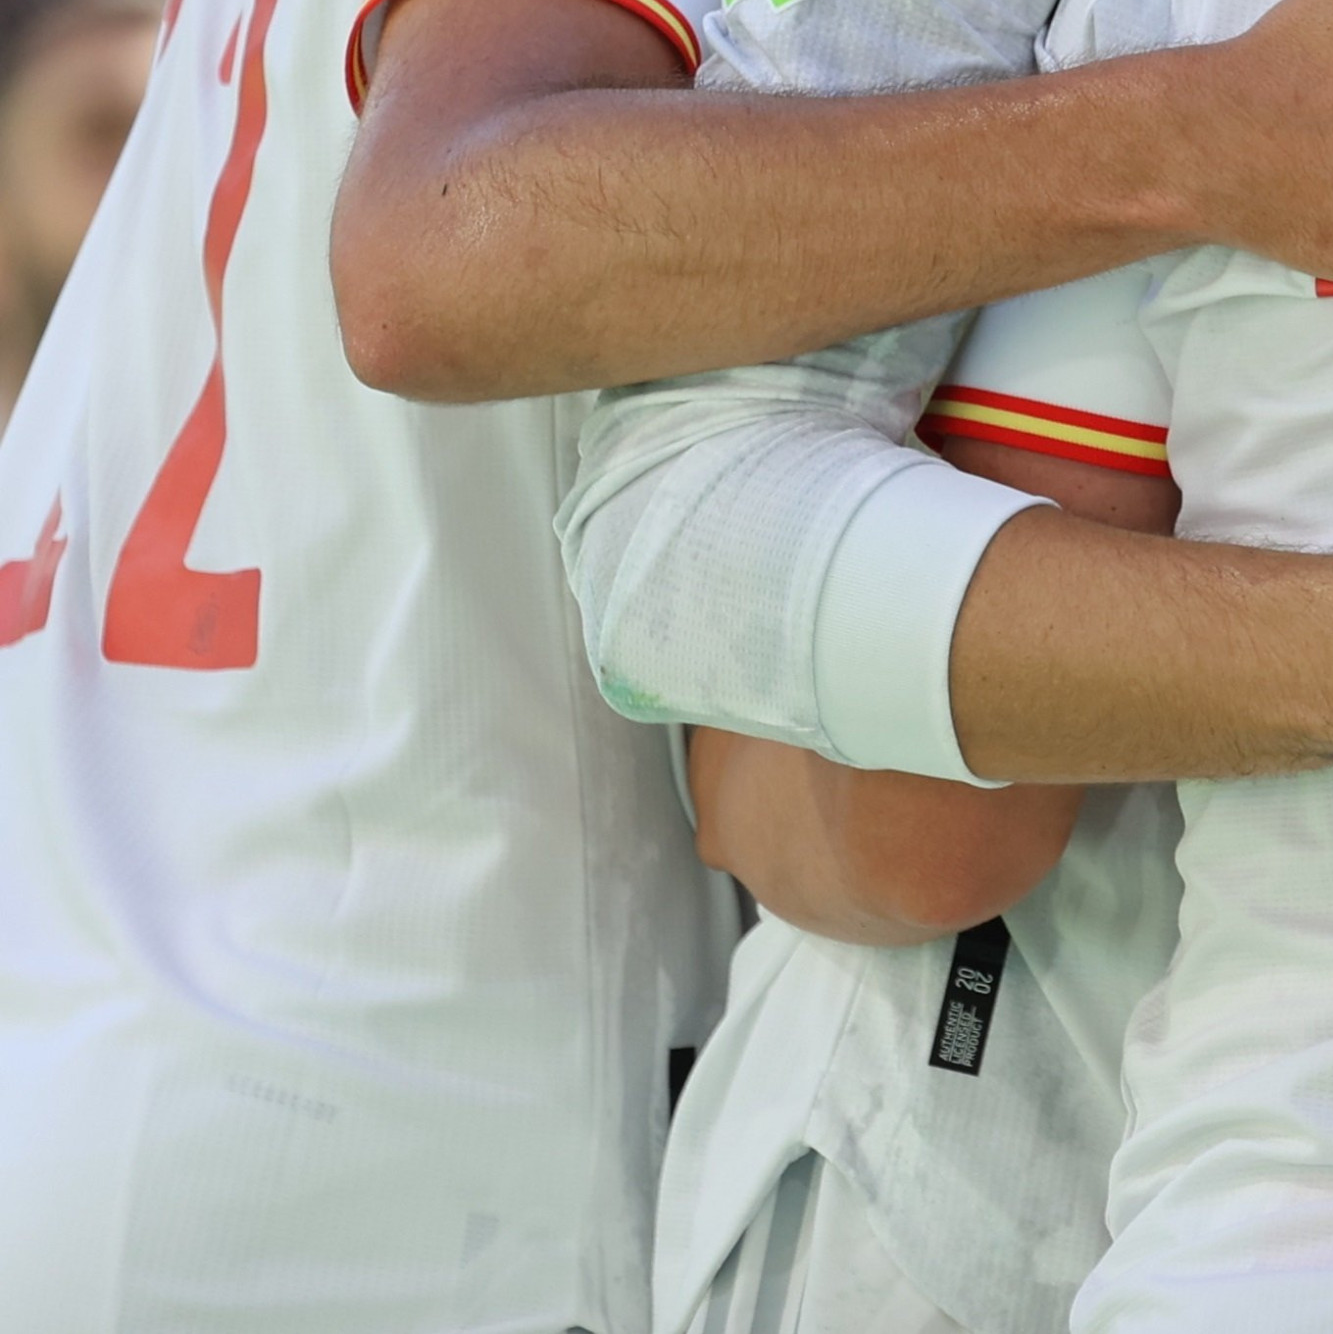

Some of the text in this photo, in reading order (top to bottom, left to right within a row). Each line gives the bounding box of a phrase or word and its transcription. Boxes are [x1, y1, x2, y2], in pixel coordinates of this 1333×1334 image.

[955, 968, 976, 991] 20
[938, 1001, 962, 1062] AUTHENTIC
[951, 1012, 972, 1065] LICENSED
[962, 1017, 984, 1067] PRODUCT
